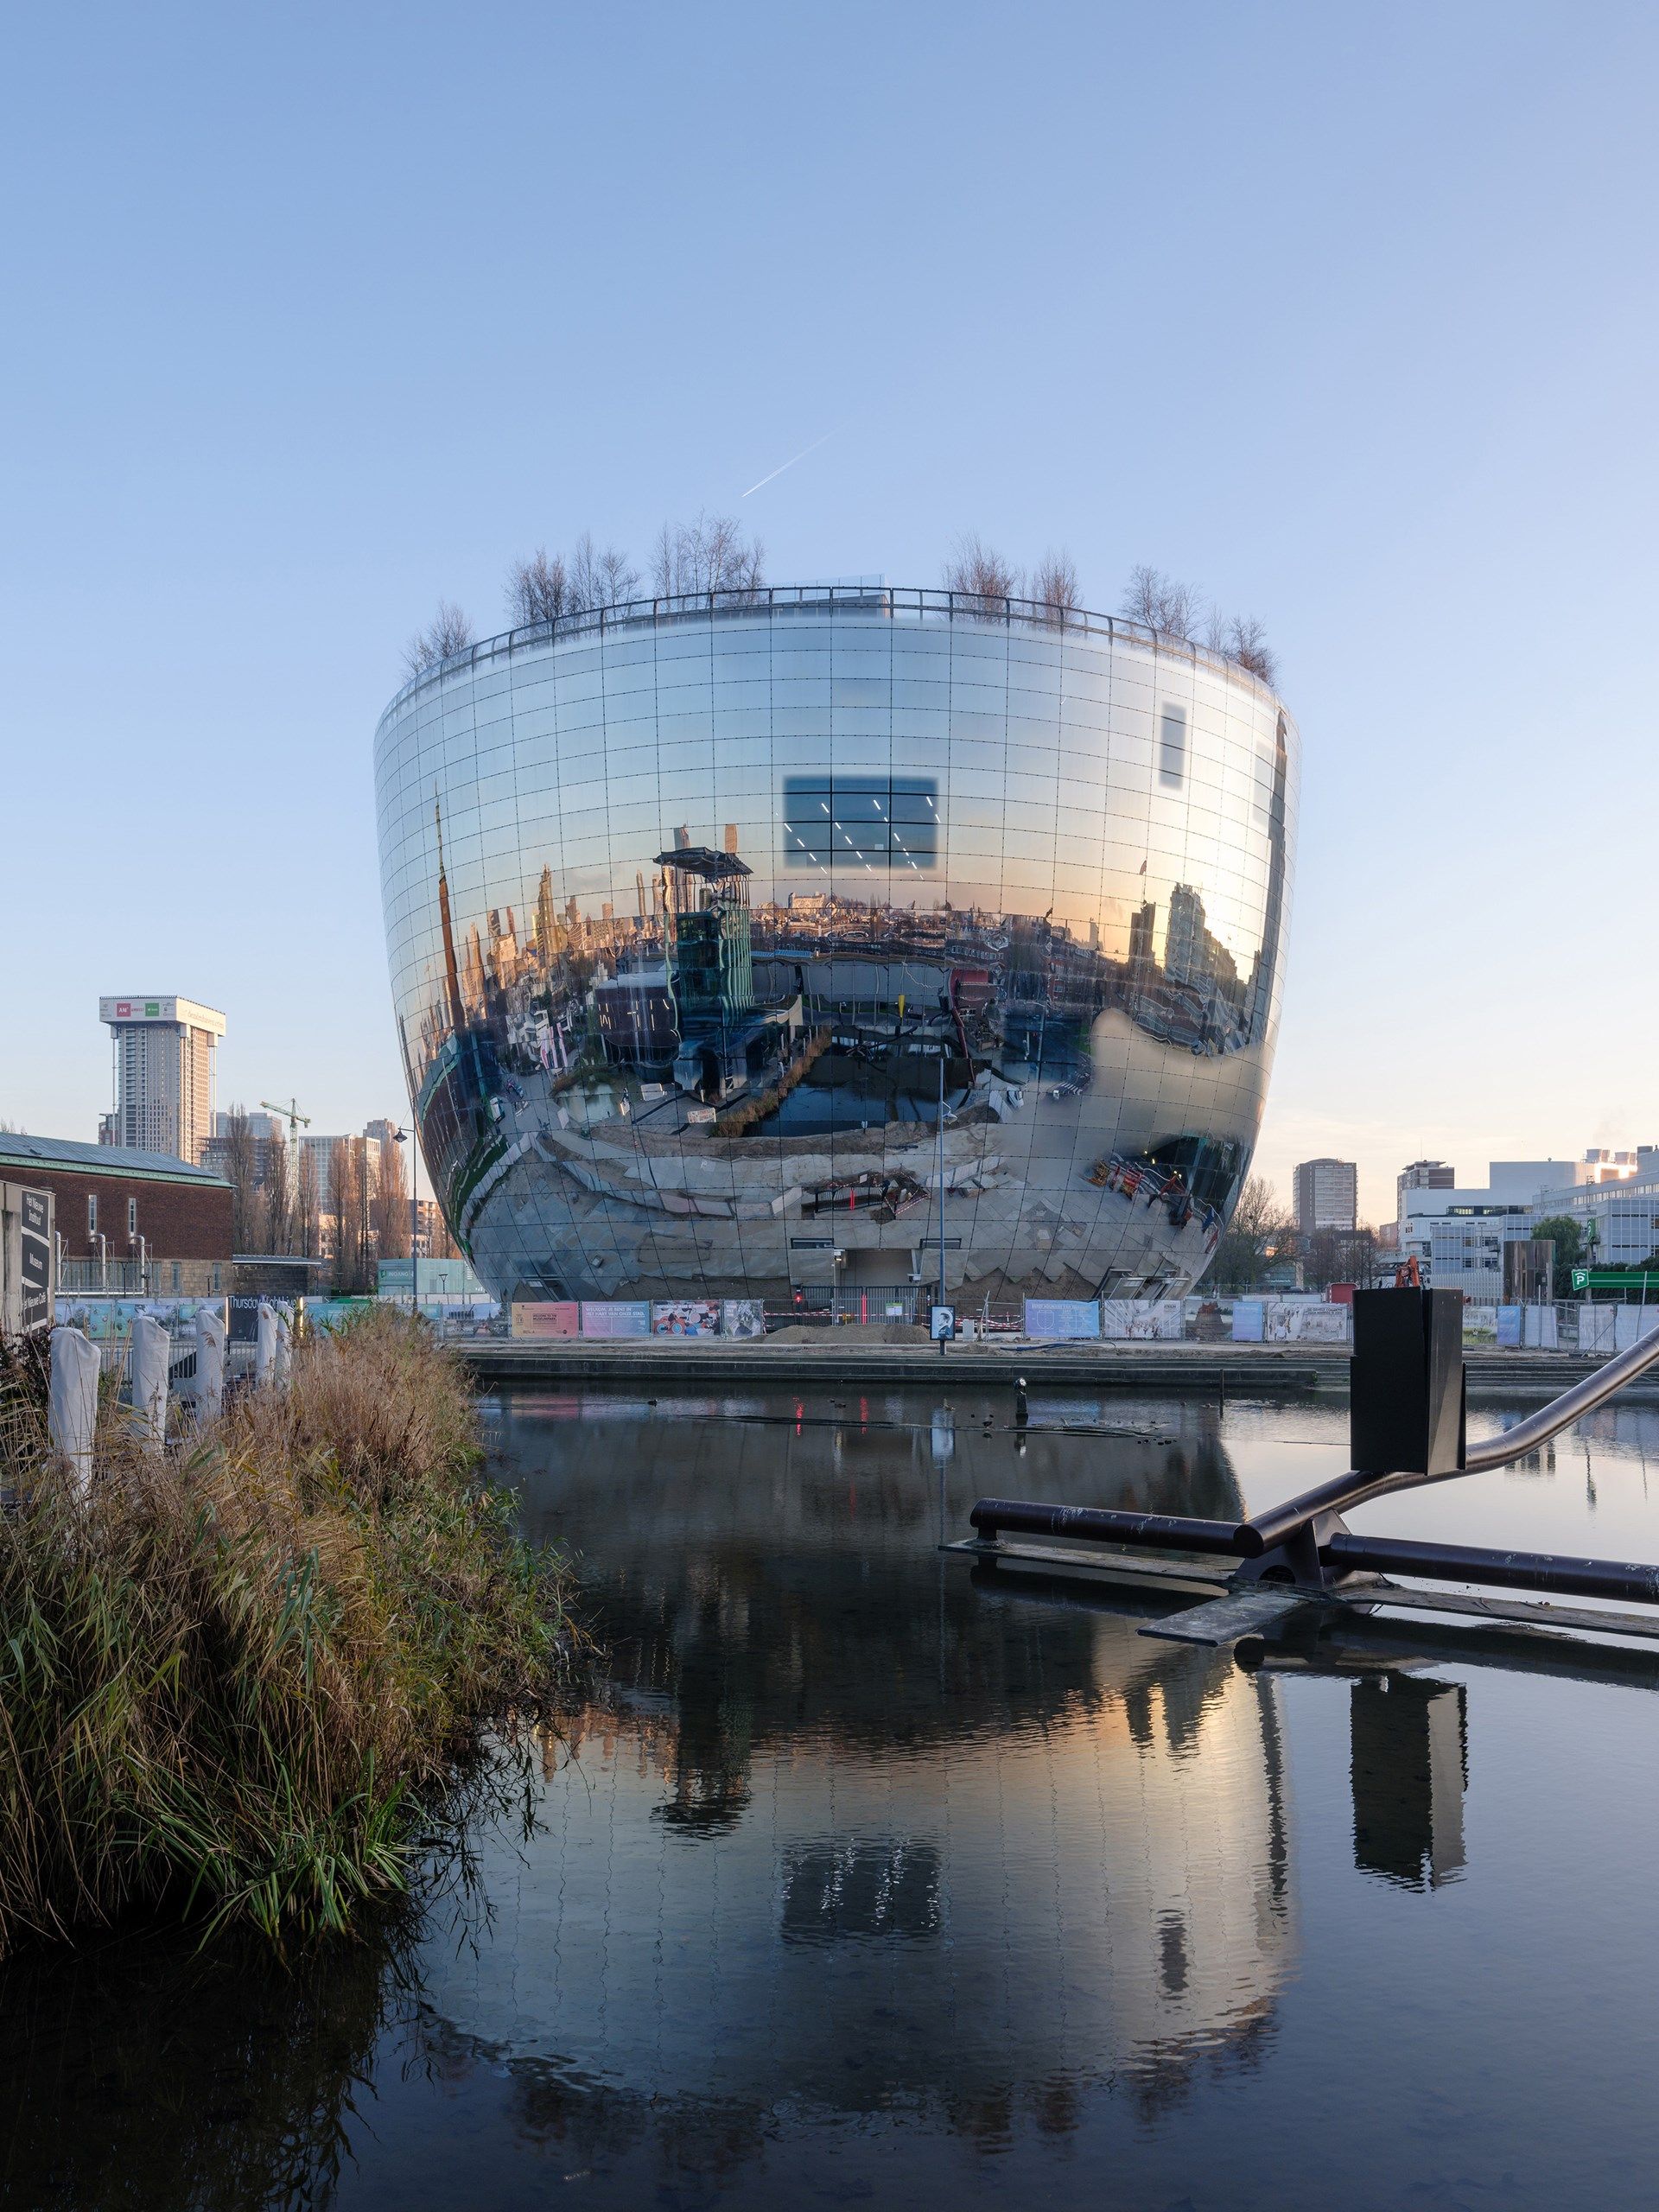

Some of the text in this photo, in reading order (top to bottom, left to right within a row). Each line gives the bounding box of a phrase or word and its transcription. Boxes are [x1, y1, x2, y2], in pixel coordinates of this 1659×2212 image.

[33, 1197, 44, 1214] Nieuwe
[29, 1252, 43, 1270] Museum
[1576, 1275, 1585, 1285] P
